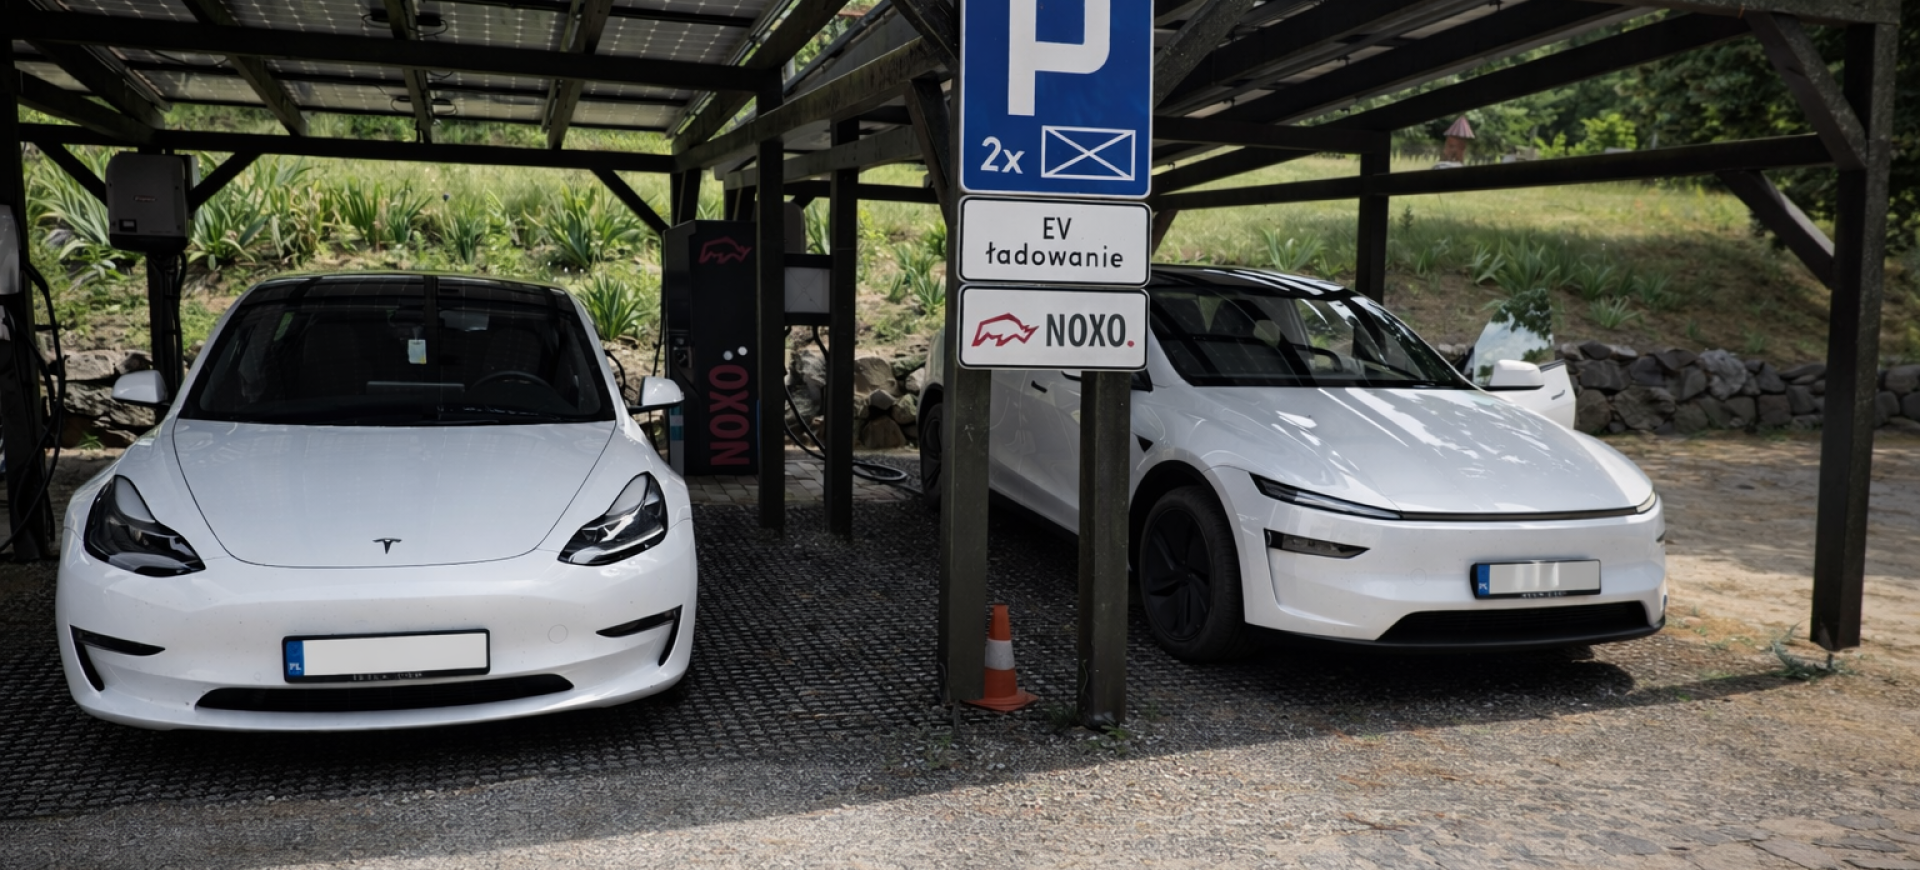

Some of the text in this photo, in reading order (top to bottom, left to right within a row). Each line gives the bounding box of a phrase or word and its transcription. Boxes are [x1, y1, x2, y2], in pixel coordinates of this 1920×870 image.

[1008, 0, 1110, 116] P
[980, 136, 1025, 174] 2x
[1043, 216, 1072, 240] EV
[985, 241, 1124, 268] ładowanie
